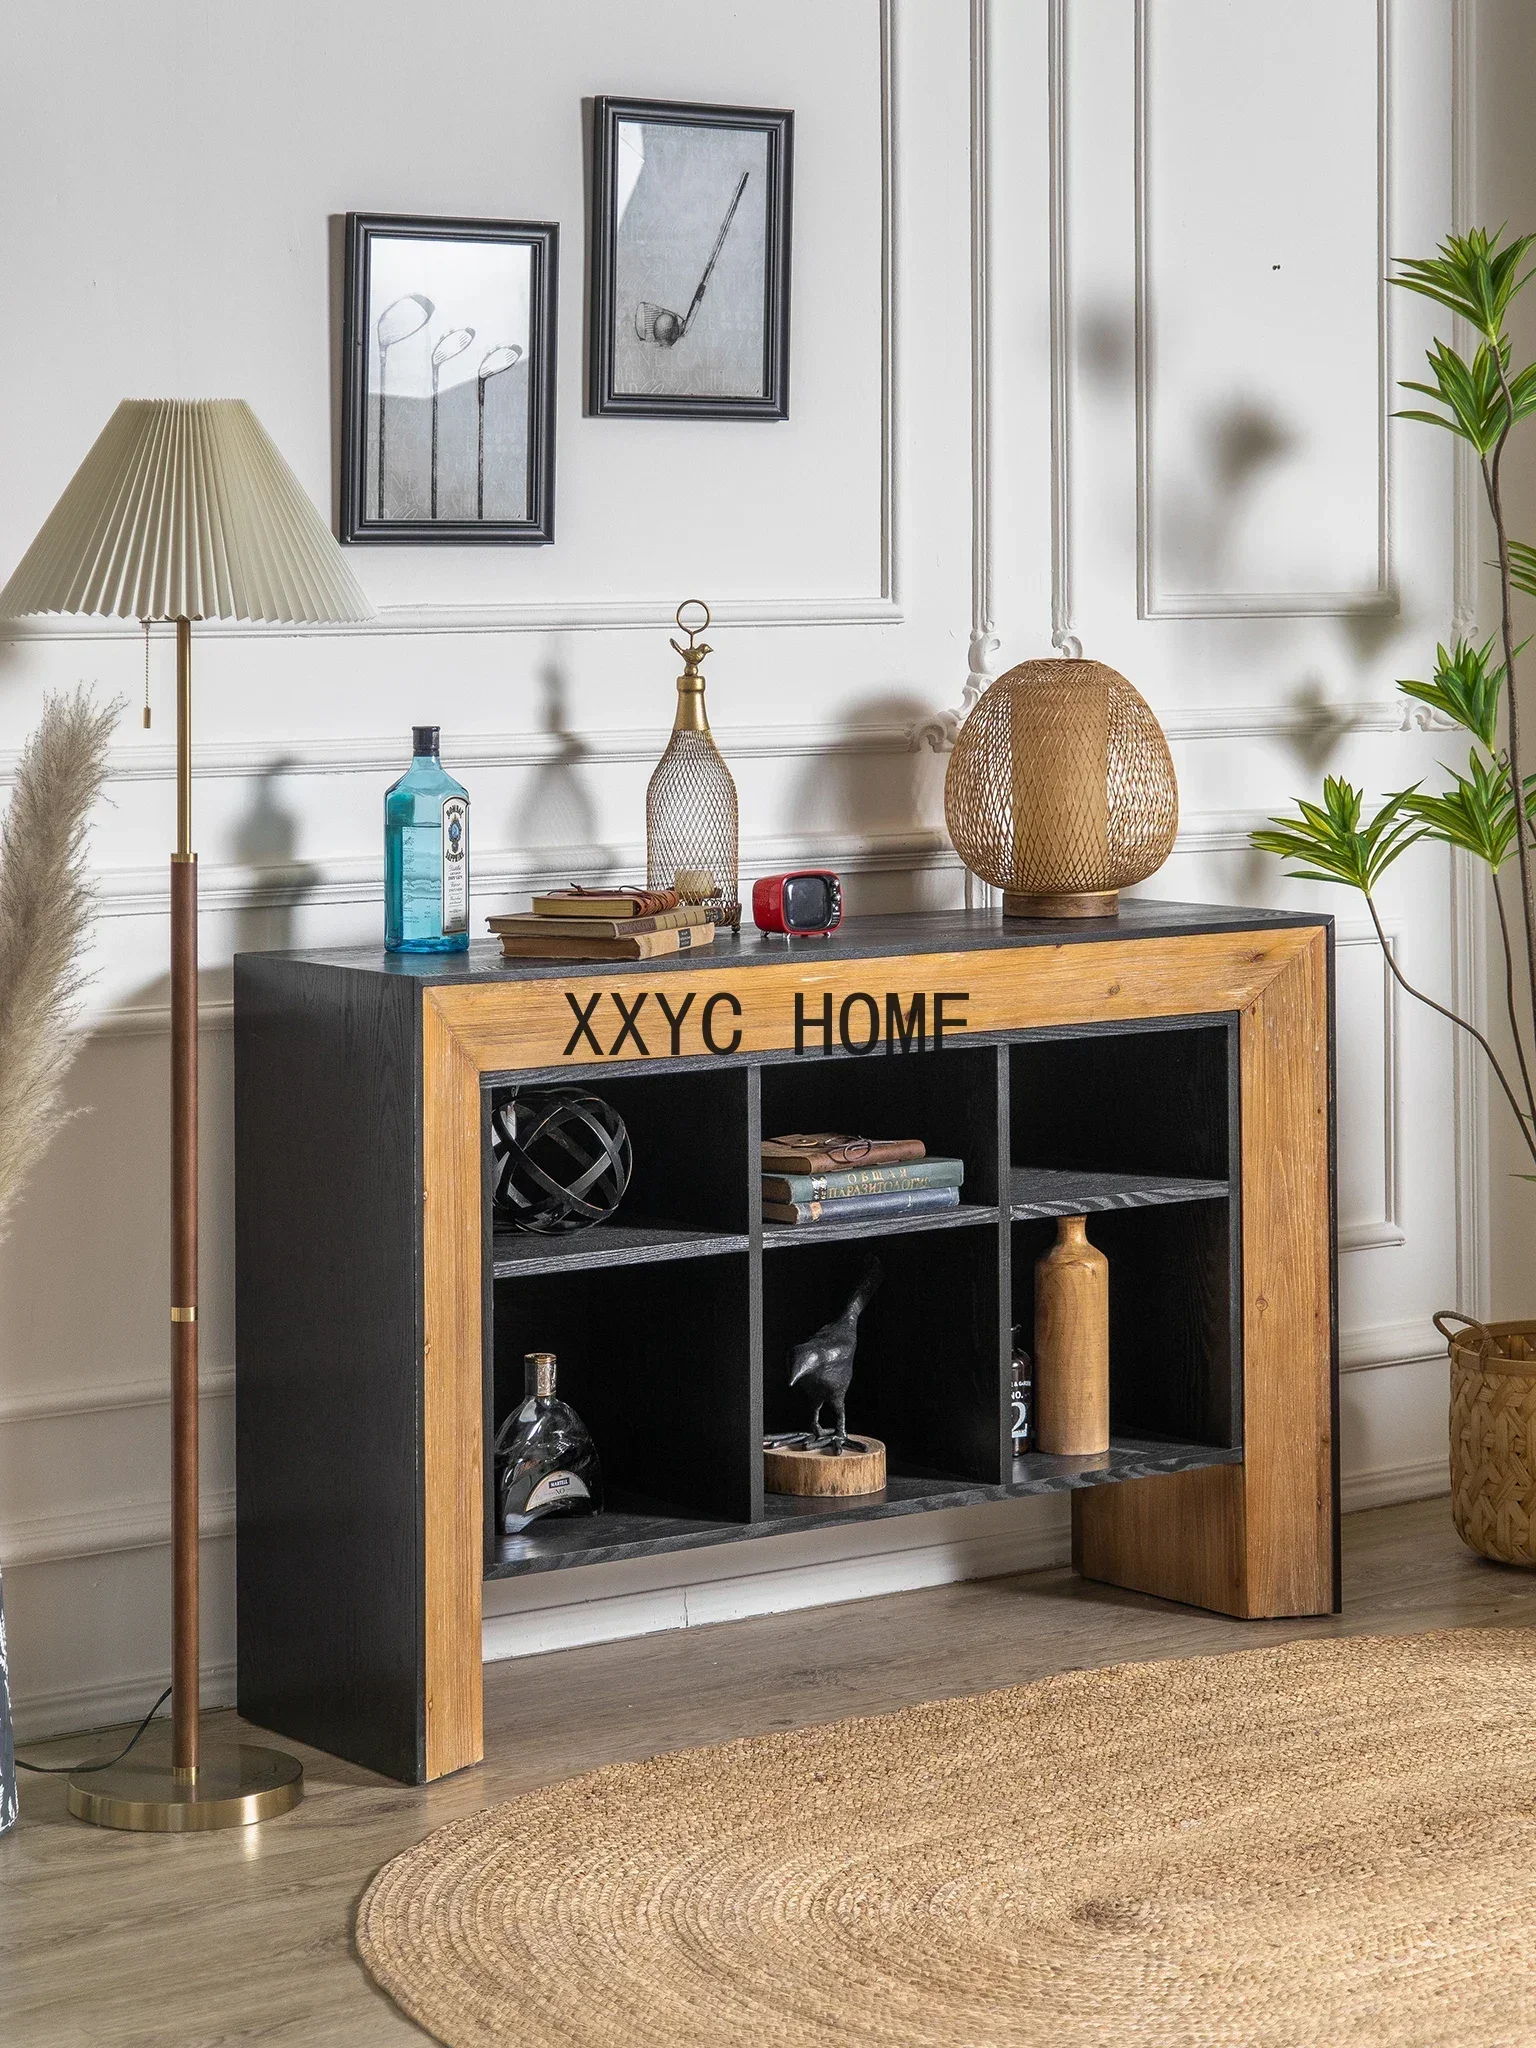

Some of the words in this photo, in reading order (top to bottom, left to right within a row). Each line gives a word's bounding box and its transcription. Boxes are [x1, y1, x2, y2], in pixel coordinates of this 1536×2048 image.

[446, 804, 464, 819] BOMBAY
[445, 848, 464, 862] SAPPHIRE
[847, 1168, 908, 1184] ОБЩАЯ
[1011, 1401, 1028, 1438] 2
